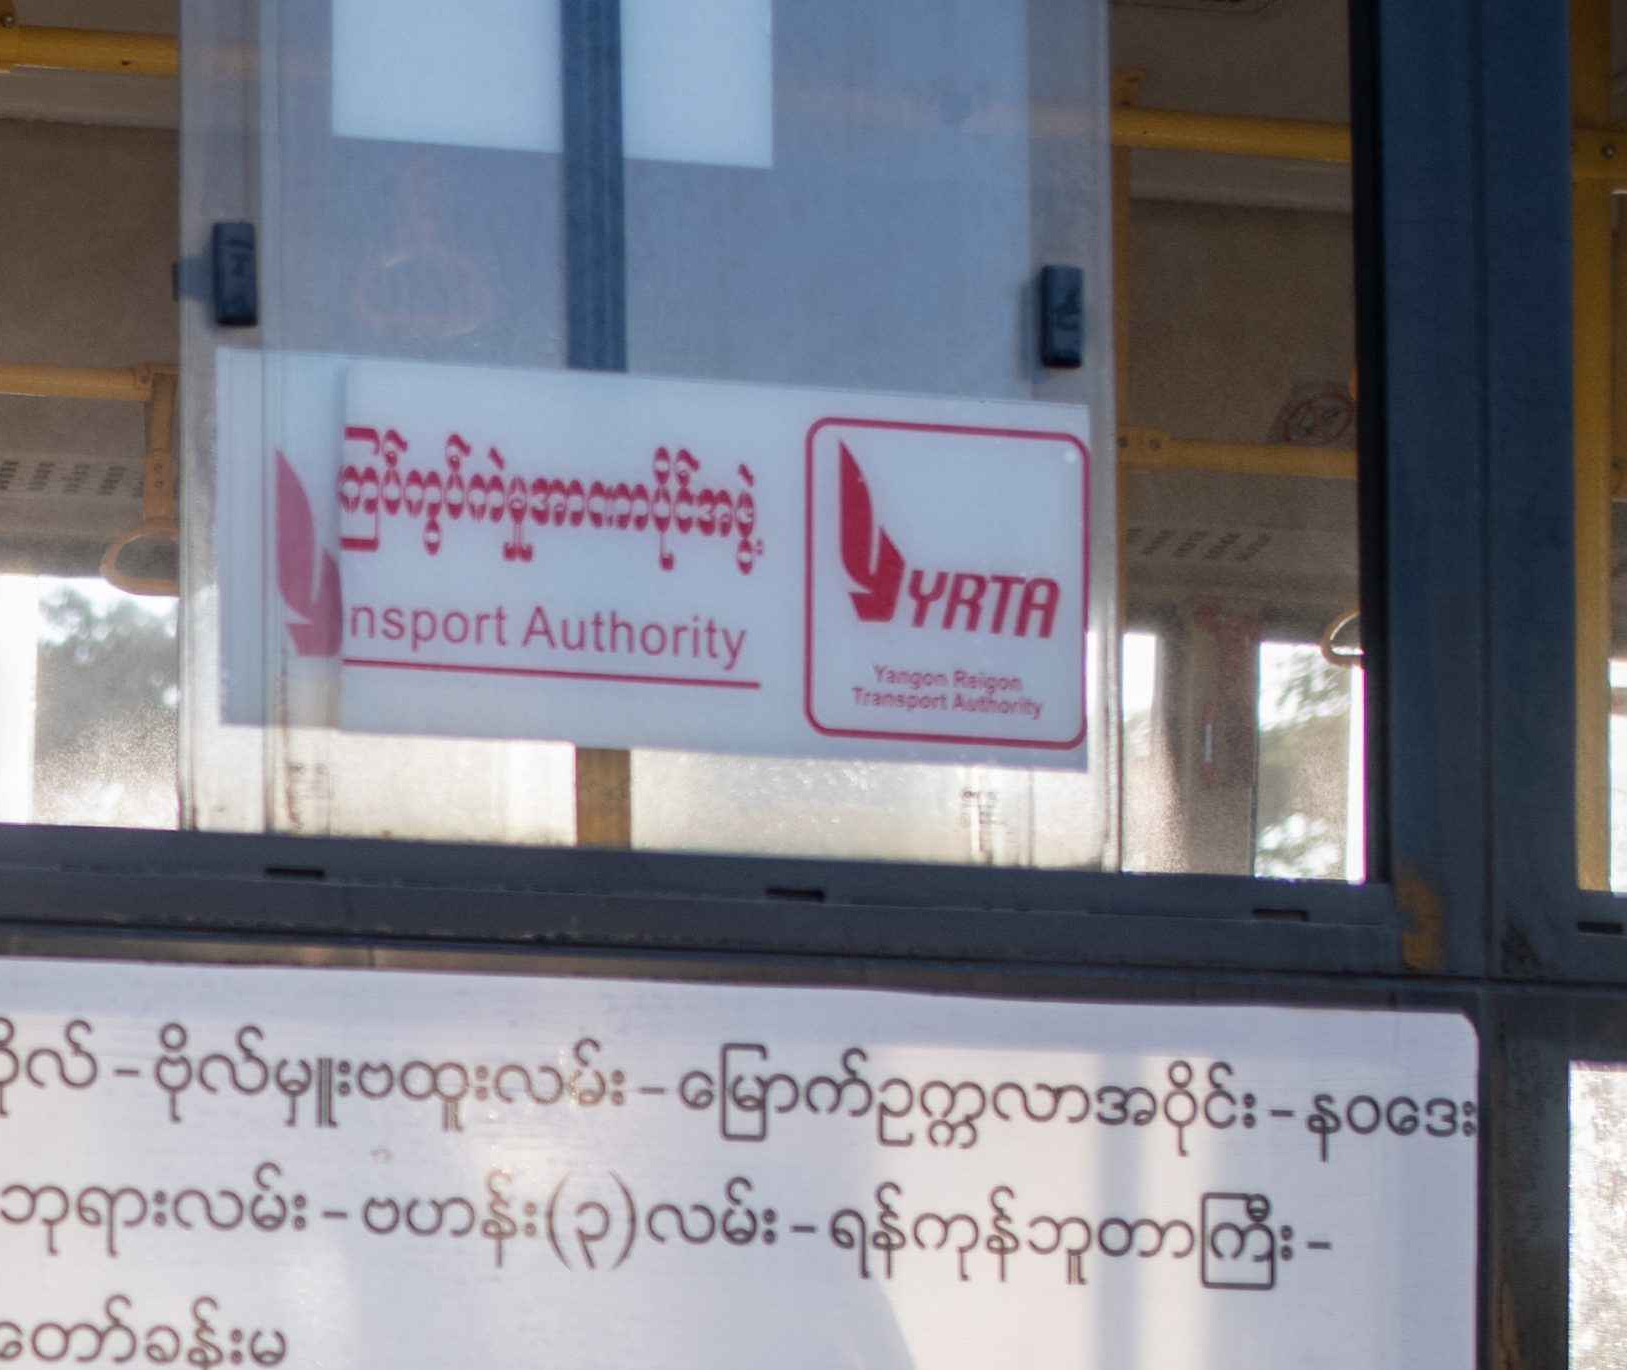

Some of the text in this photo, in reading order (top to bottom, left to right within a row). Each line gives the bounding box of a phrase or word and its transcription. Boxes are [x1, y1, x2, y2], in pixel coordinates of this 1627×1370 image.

[907, 568, 1061, 640] YRTA
[349, 604, 748, 672] nsport Authority
[851, 686, 1045, 720] Transport Authority
[873, 664, 1024, 695] Yangon Reigon
